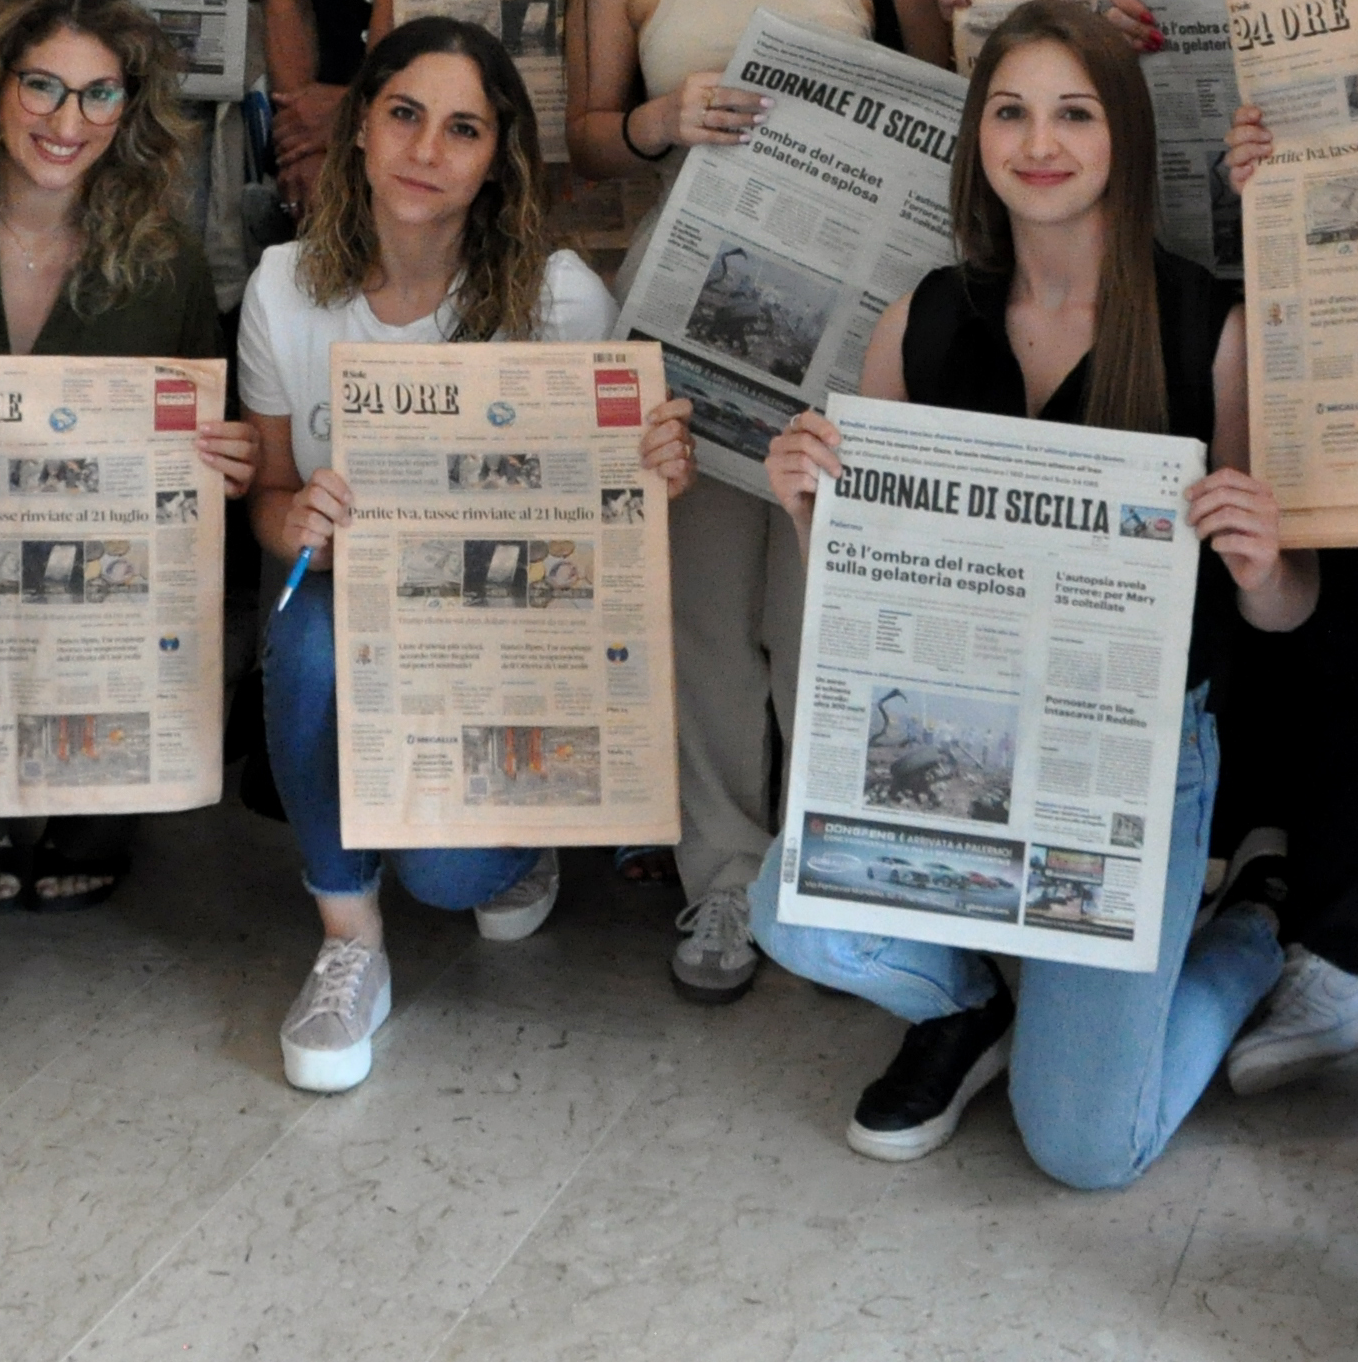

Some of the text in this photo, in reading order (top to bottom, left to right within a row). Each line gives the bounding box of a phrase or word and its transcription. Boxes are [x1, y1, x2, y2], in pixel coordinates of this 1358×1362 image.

[1235, 11, 1275, 51] 24
[740, 61, 855, 117] GIORNALE
[853, 95, 886, 132] DI
[883, 109, 959, 165] SICILI
[752, 139, 879, 205] gelateria esplosa
[809, 144, 835, 167] del
[835, 157, 884, 189] racket
[342, 383, 460, 415] 24 ORE
[21, 510, 73, 522] rinviate
[76, 510, 88, 521] al
[91, 510, 106, 522] 21
[109, 509, 149, 525] luglio
[348, 506, 594, 524] Partite Iva, tasse rinviate al 21 luglio
[834, 465, 961, 516] GIORNALE
[967, 484, 1000, 520] DI
[1005, 488, 1110, 534] SICILIA
[825, 558, 1026, 599] sulla gelateria esplosa
[826, 539, 1025, 581] C'è l'ombra del racket
[1055, 571, 1115, 587] L'autopsia
[1054, 594, 1125, 613] 35 coltellate
[1104, 591, 1124, 601] per
[1125, 591, 1156, 606] Mary
